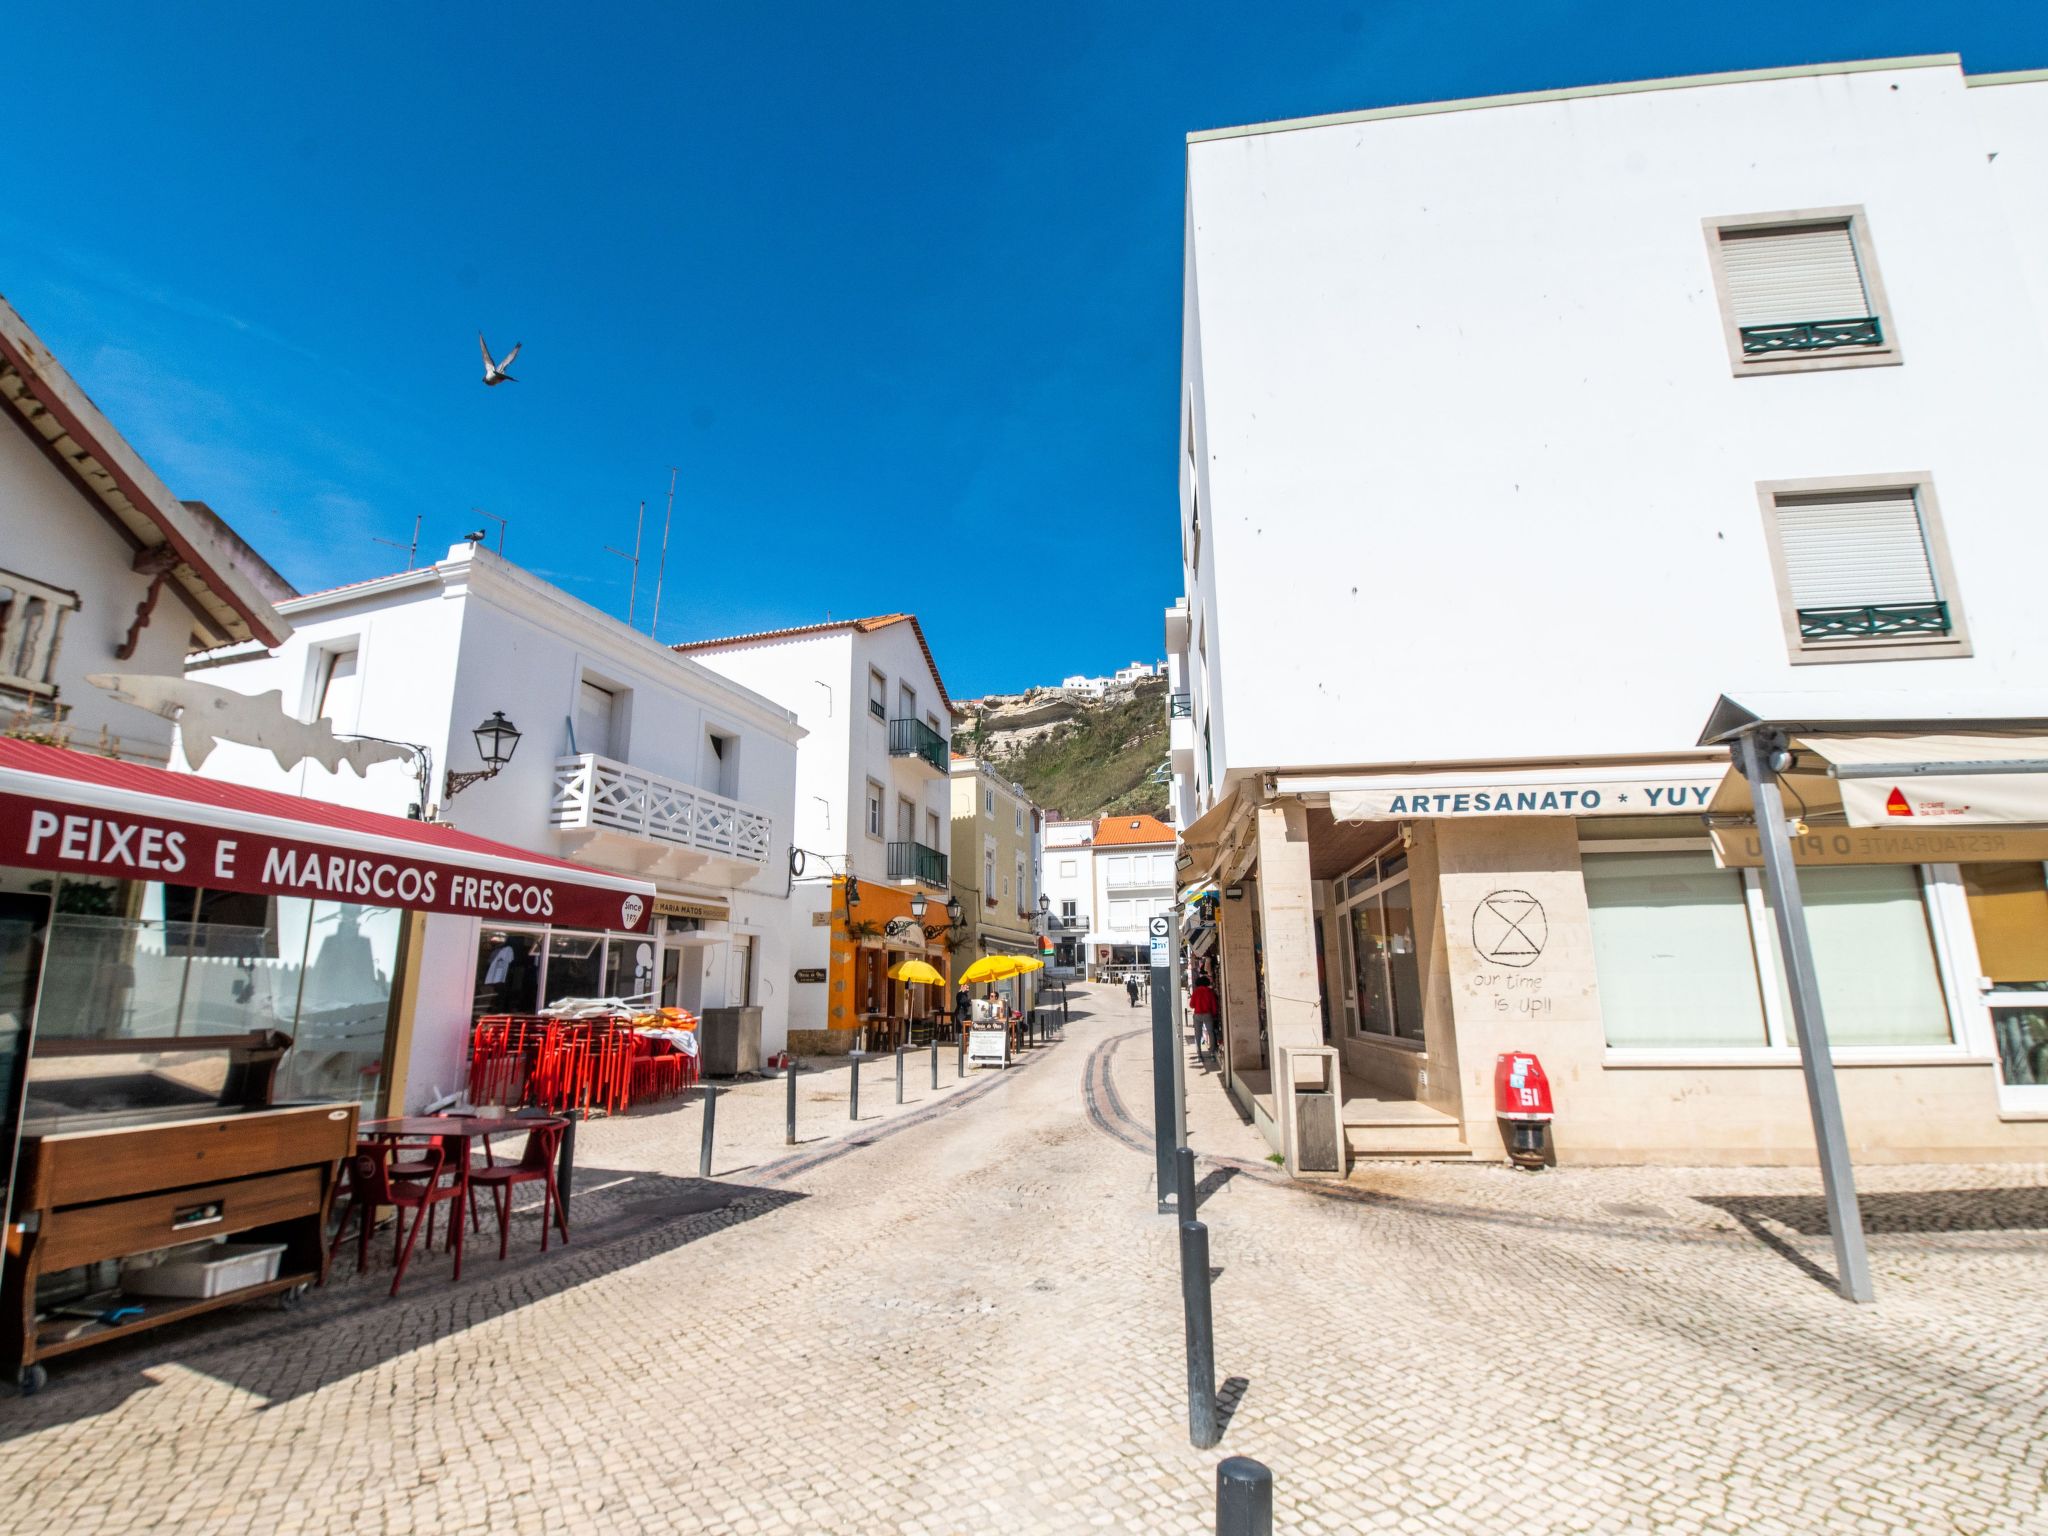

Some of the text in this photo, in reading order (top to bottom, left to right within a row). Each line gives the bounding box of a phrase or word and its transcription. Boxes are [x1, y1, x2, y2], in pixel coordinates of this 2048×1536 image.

[1389, 790, 1601, 813] ARTESANATO
[25, 809, 554, 917] PEIXES E MARISCOS FRESCOS
[624, 901, 642, 912] Since
[660, 903, 680, 913] MARIA
[681, 906, 702, 915] MATOS
[1474, 973, 1542, 990] our time
[1494, 993, 1509, 1011] is
